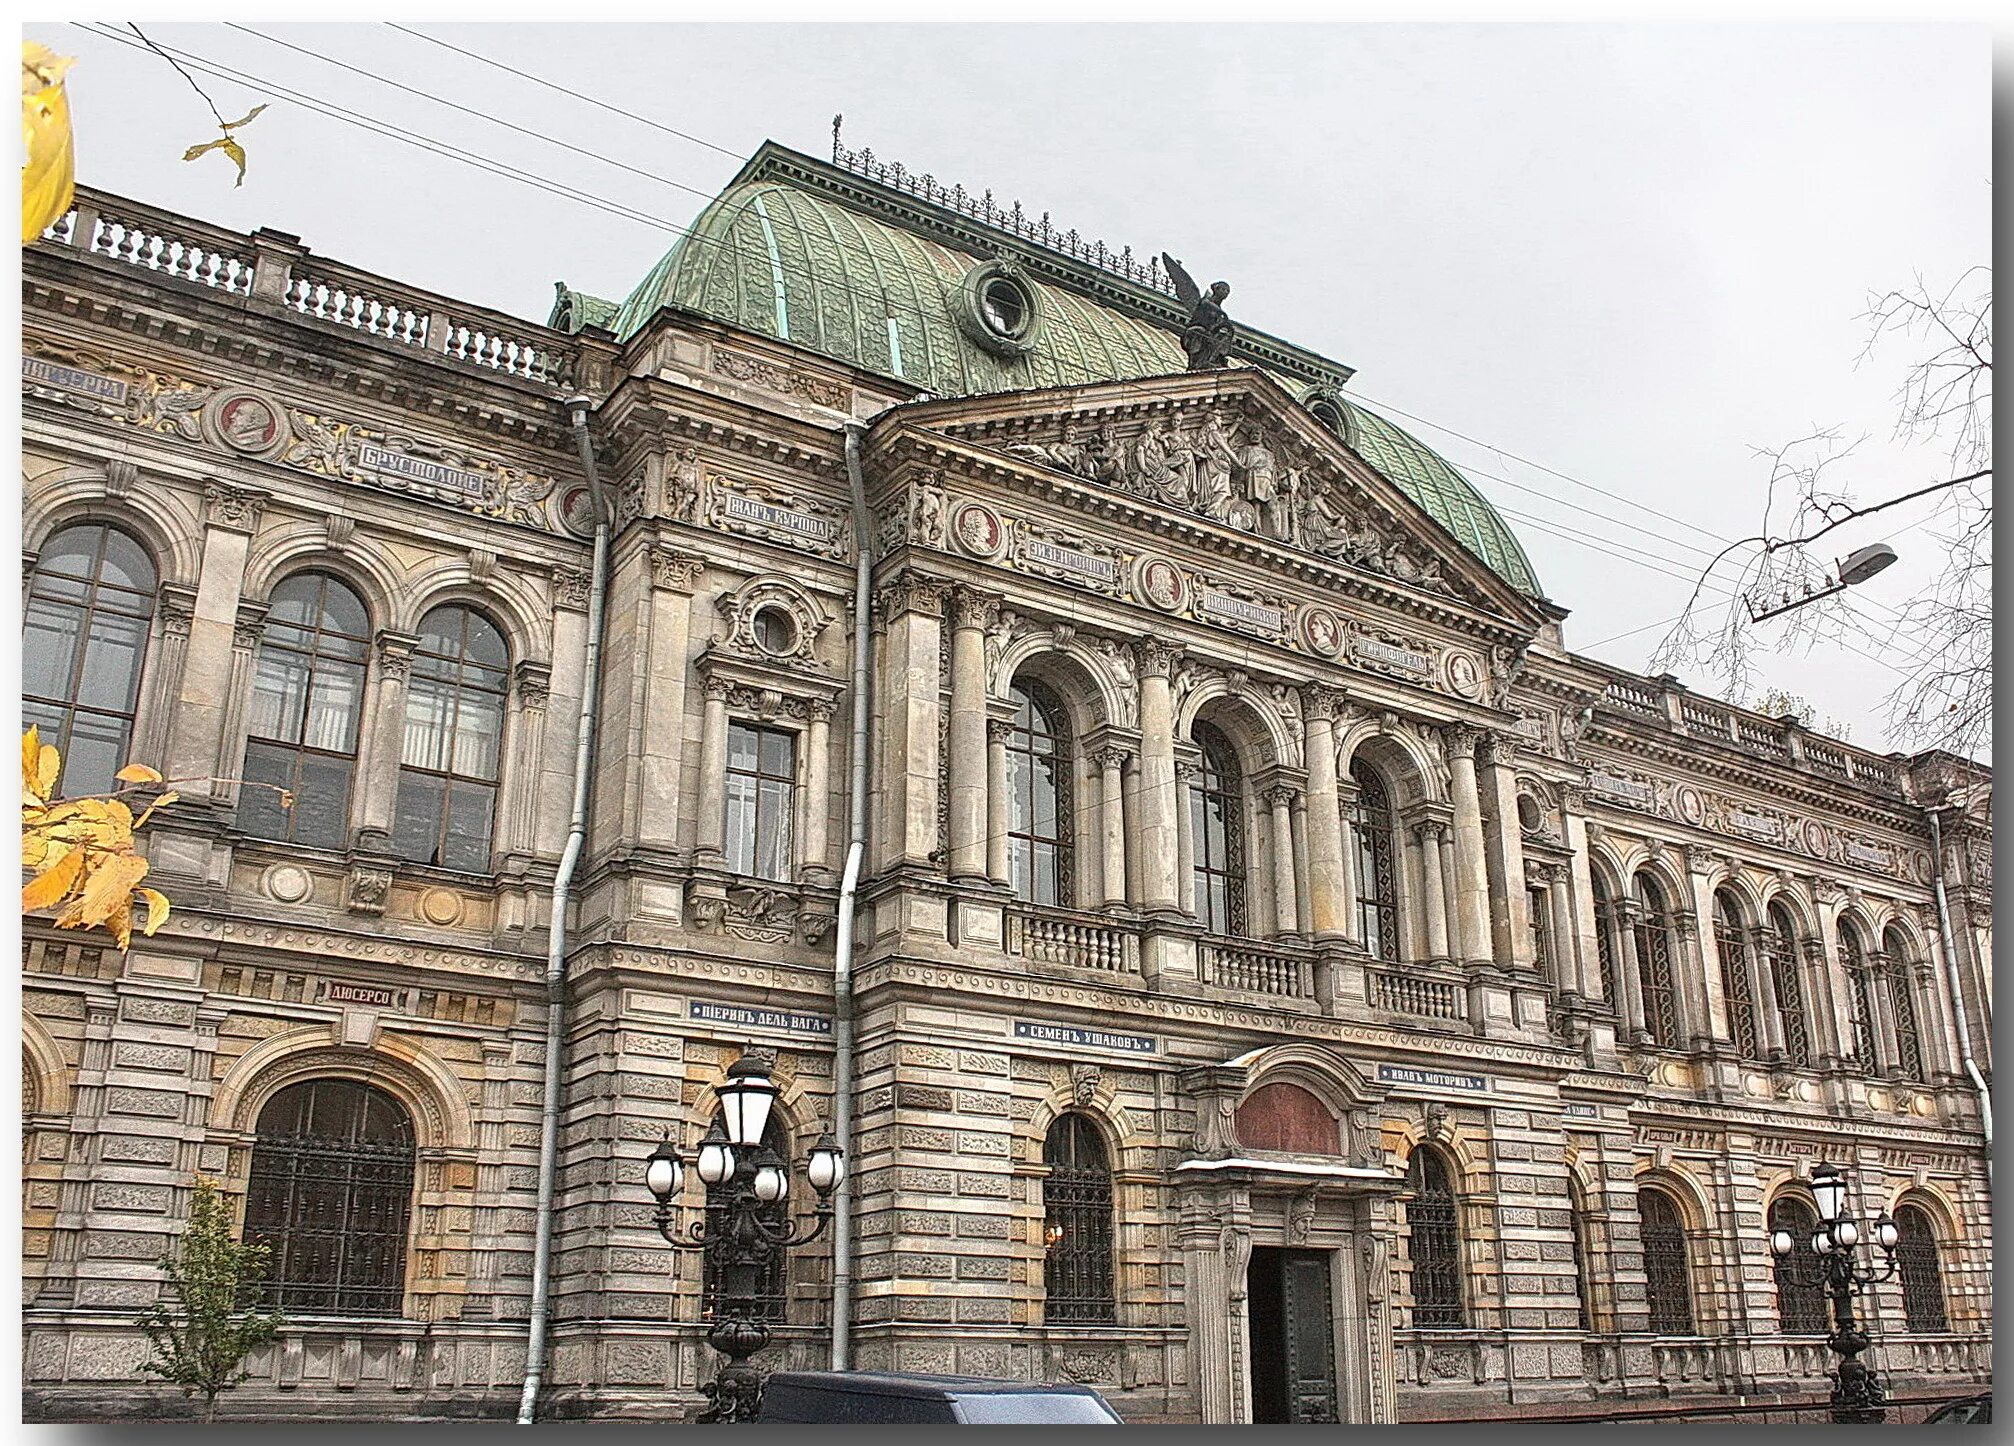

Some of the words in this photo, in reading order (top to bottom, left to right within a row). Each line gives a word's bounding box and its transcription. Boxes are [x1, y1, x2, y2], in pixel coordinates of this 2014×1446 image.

[732, 498, 770, 521] ЖАНЪ
[332, 985, 389, 1004] ДЮСЕРСО
[758, 1012, 788, 1027] ДЕЛЬ
[791, 1016, 820, 1031] ВАГА
[1030, 1025, 1080, 1043] СЕМЕНЪ
[1085, 1032, 1141, 1050] УШАКОВЪ
[1391, 1069, 1423, 1083] ИВАНЪ
[1425, 1072, 1474, 1088] МОТОРИНЪ
